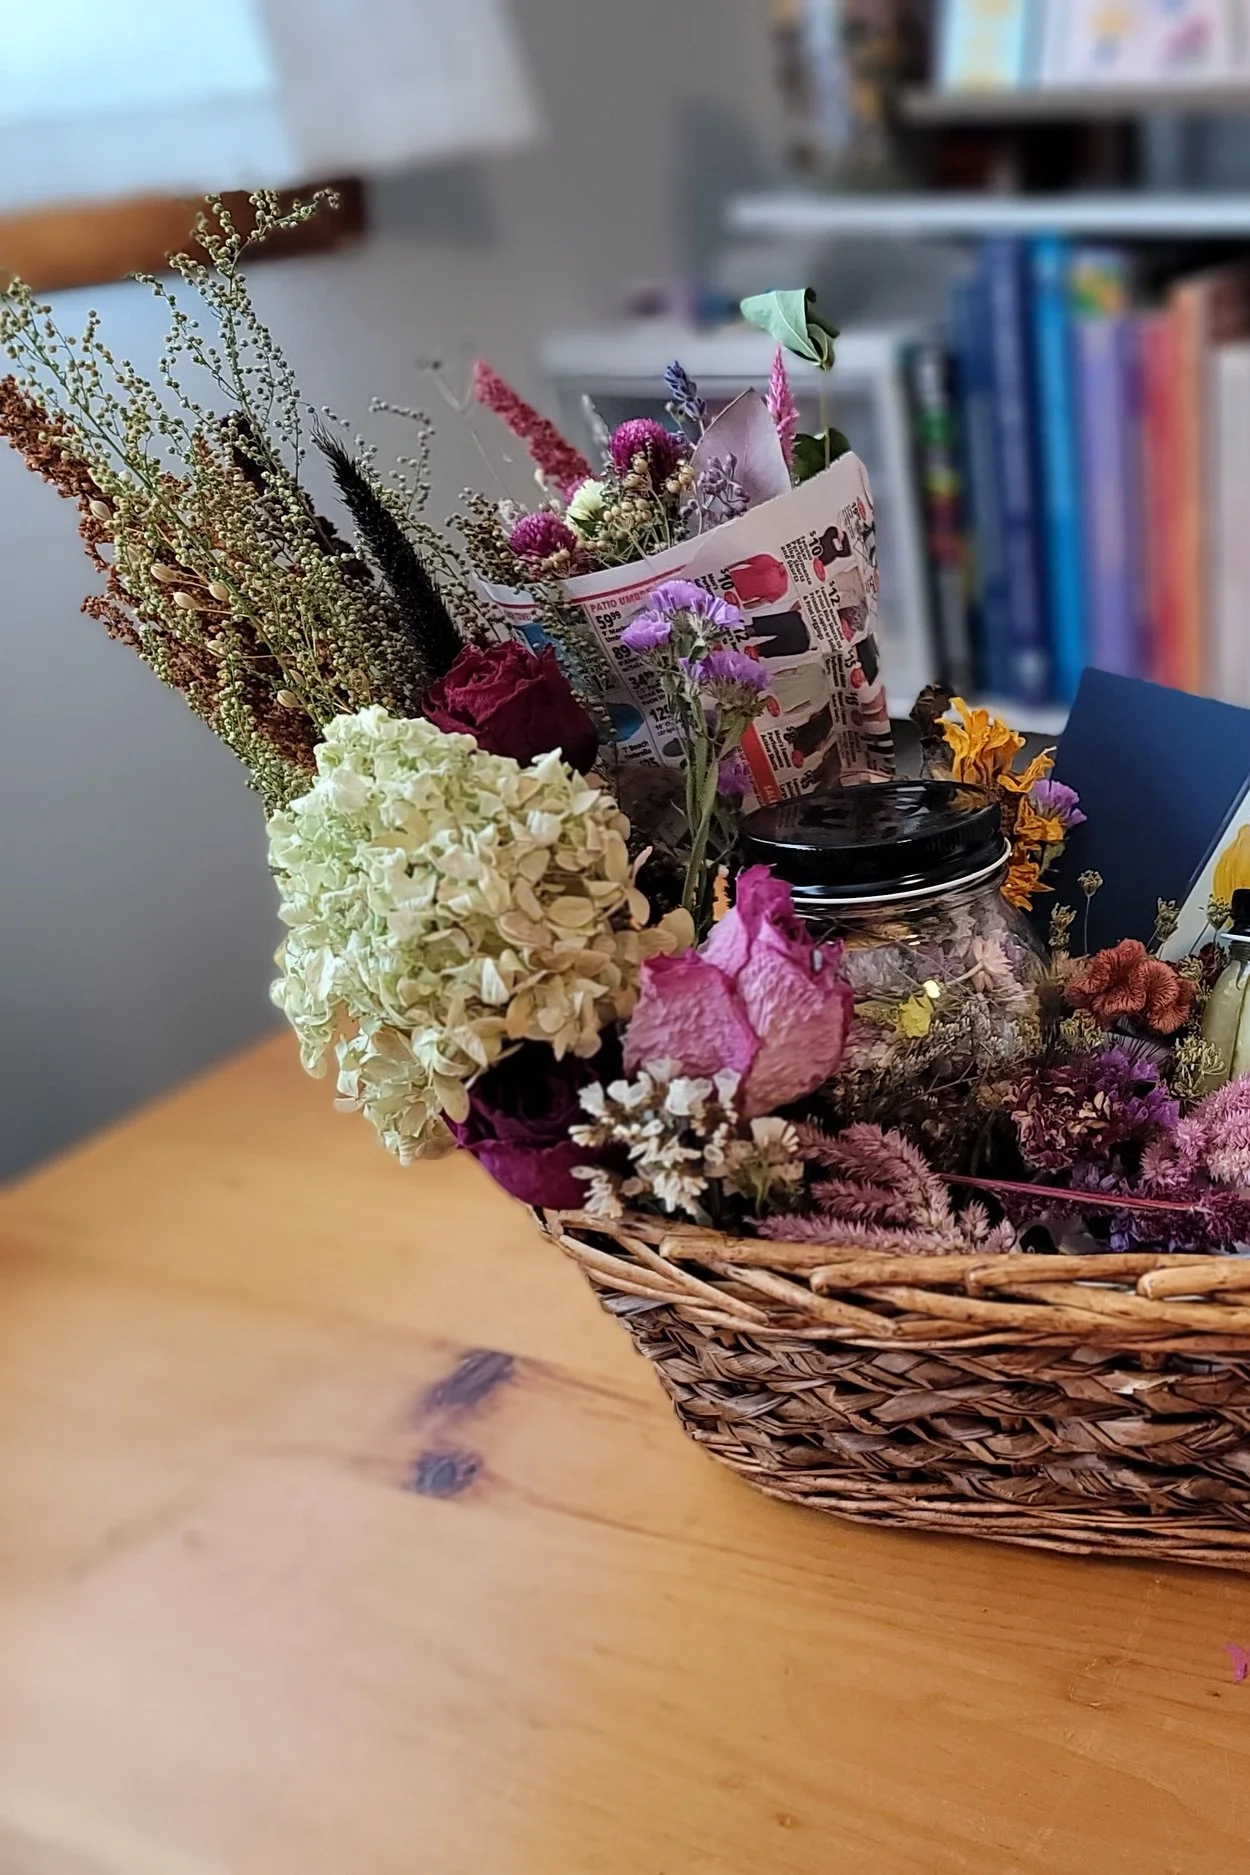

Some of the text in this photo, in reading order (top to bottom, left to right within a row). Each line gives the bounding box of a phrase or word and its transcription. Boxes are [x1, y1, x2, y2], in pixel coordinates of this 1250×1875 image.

[809, 530, 823, 556] $10
[718, 568, 735, 590] $10
[590, 599, 617, 612] PATIO
